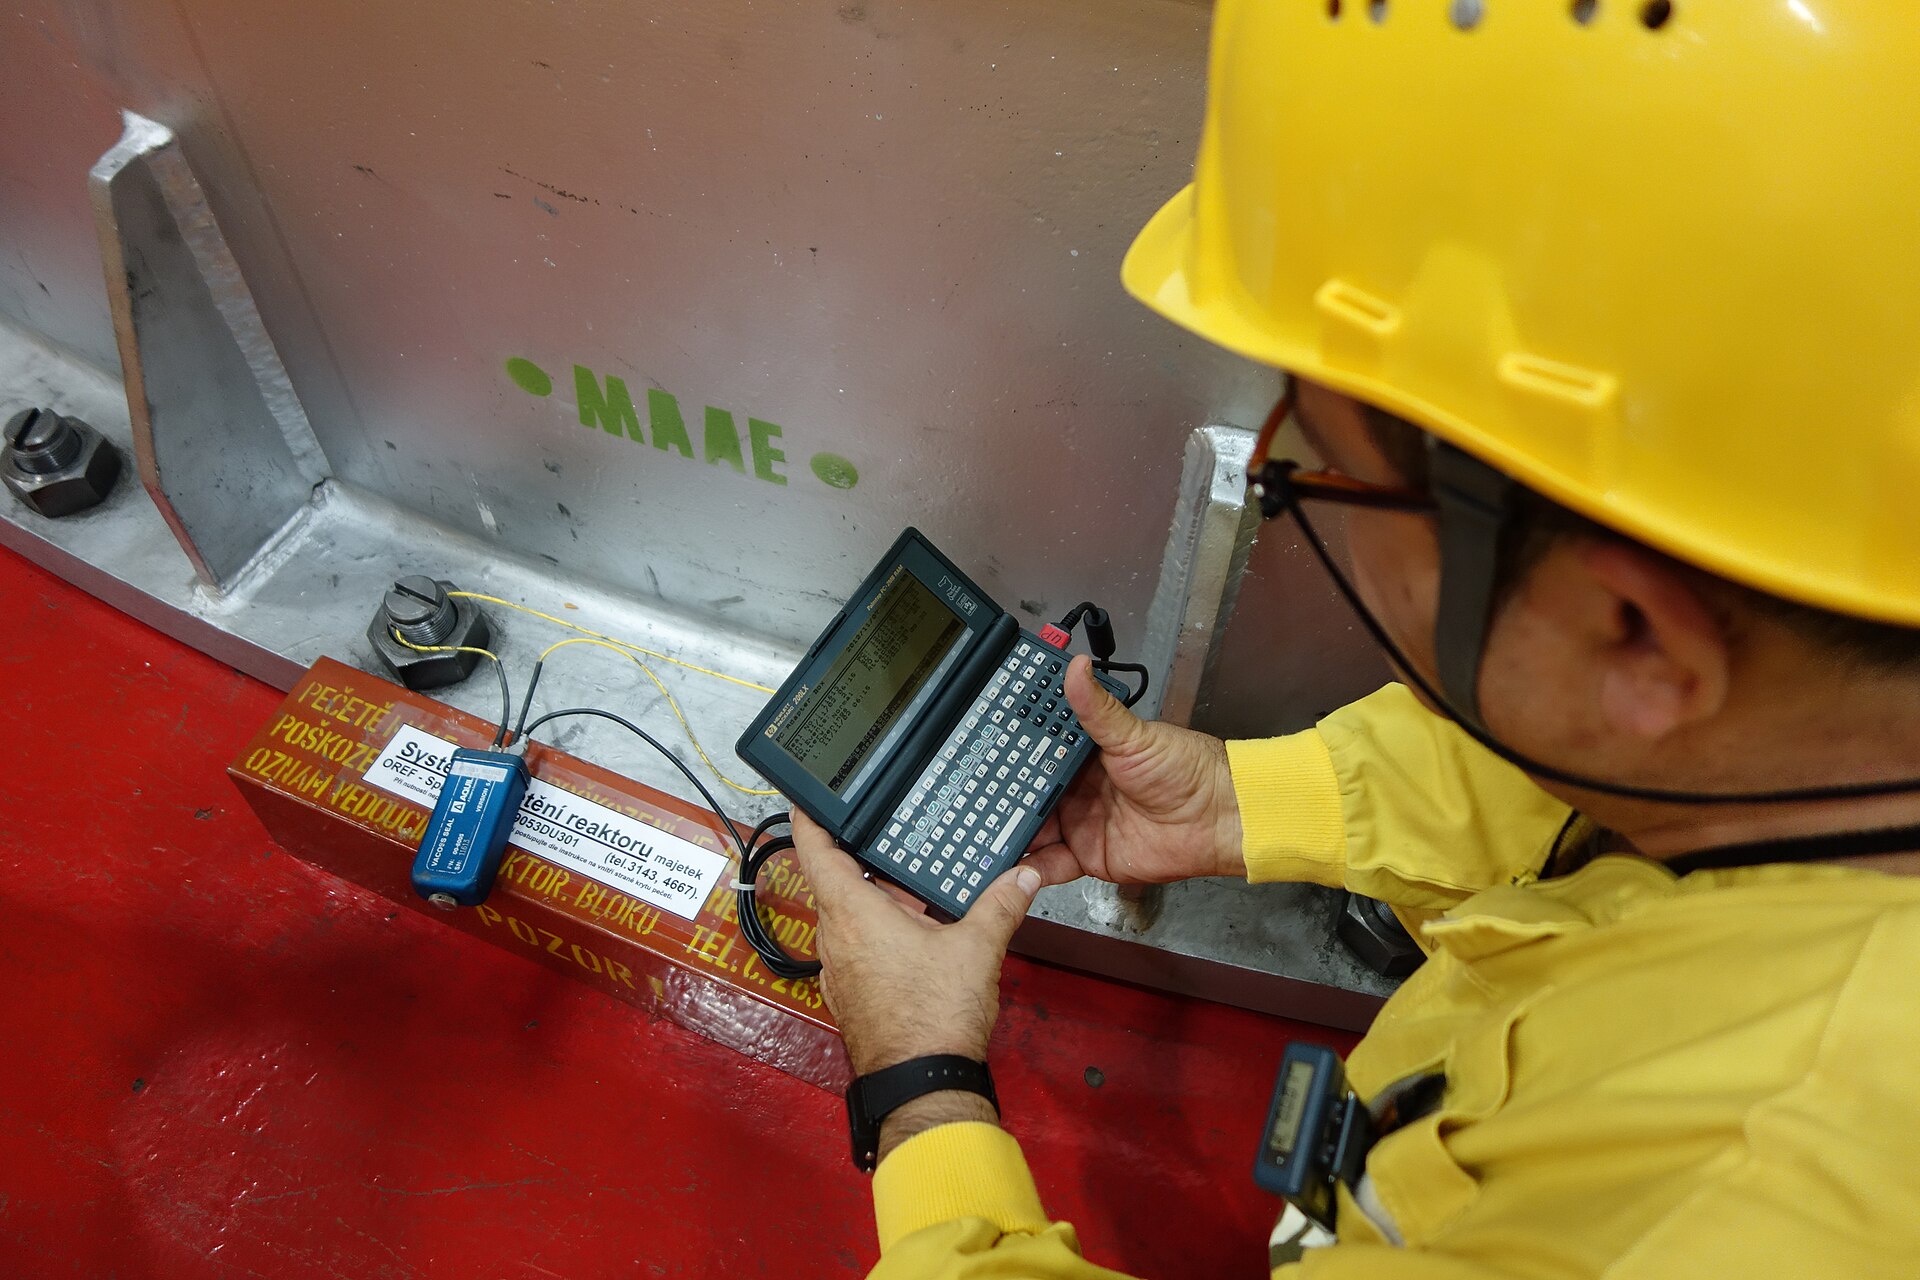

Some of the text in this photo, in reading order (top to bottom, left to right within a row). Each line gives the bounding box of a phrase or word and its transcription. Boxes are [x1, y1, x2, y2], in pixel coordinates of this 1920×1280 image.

[573, 364, 788, 485] MAAE
[298, 681, 394, 732] PEČETĚ
[791, 683, 810, 705] 200LX
[774, 731, 785, 743] PC
[246, 747, 329, 798] OZNAM
[458, 776, 474, 801] AQUIL
[475, 787, 489, 813] VERSION
[382, 758, 419, 777] OREF
[662, 873, 699, 900] 4667).
[442, 816, 455, 837] SEAL
[514, 829, 547, 846] postupujte
[558, 847, 587, 863] instrukce
[566, 811, 654, 860] reaktoru
[654, 853, 704, 882] majetek
[575, 882, 660, 936] BLOKU
[477, 905, 635, 989] POZOR
